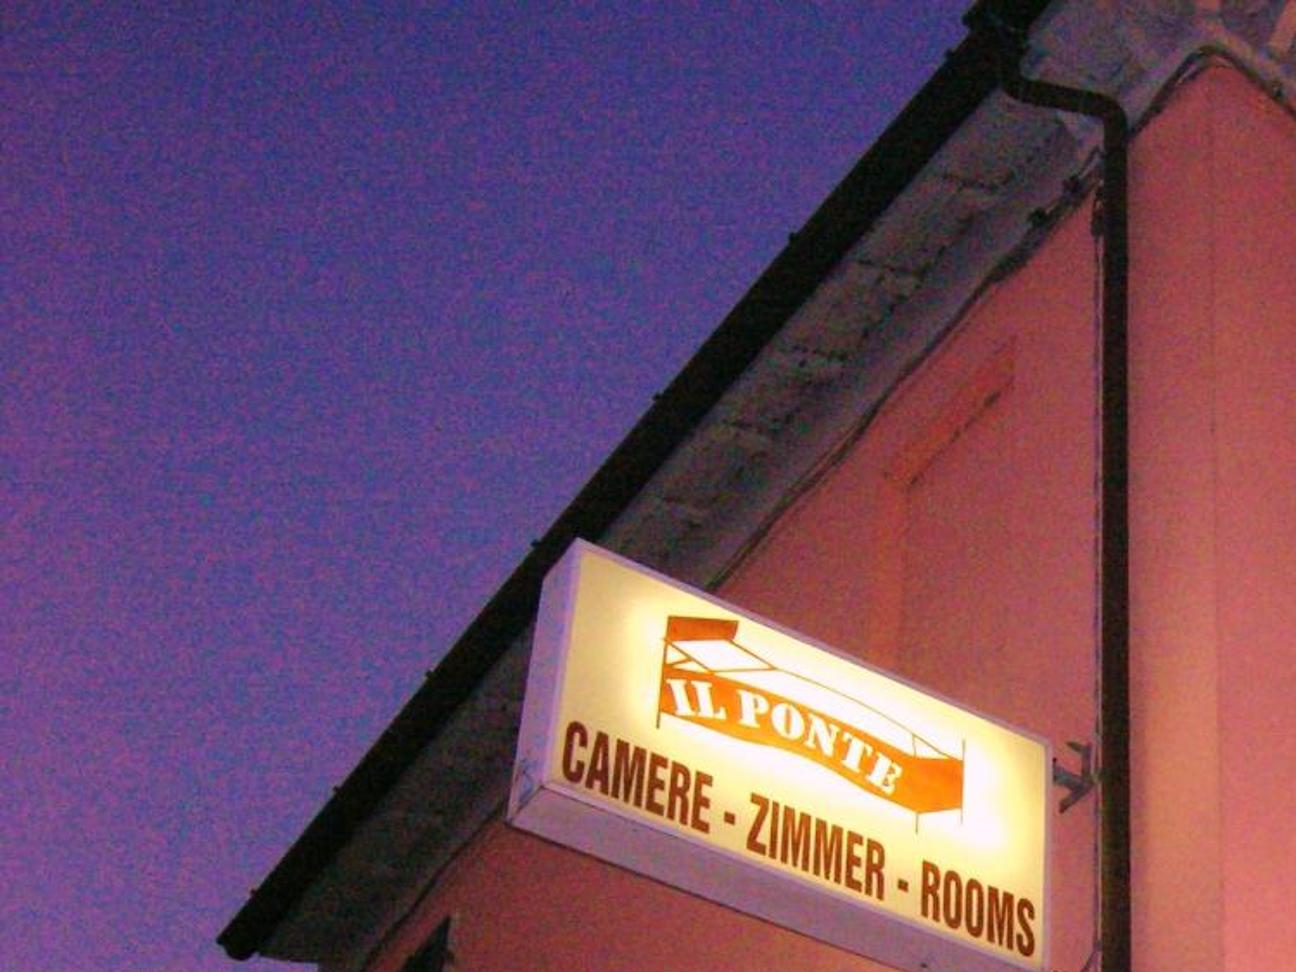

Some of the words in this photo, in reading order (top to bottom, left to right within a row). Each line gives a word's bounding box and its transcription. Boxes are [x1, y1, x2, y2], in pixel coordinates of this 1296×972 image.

[666, 678, 726, 720] IL
[738, 690, 903, 794] PONTE
[562, 721, 714, 834] CAMERE
[746, 793, 886, 901] ZIMMER
[920, 860, 1036, 958] ROOMS
